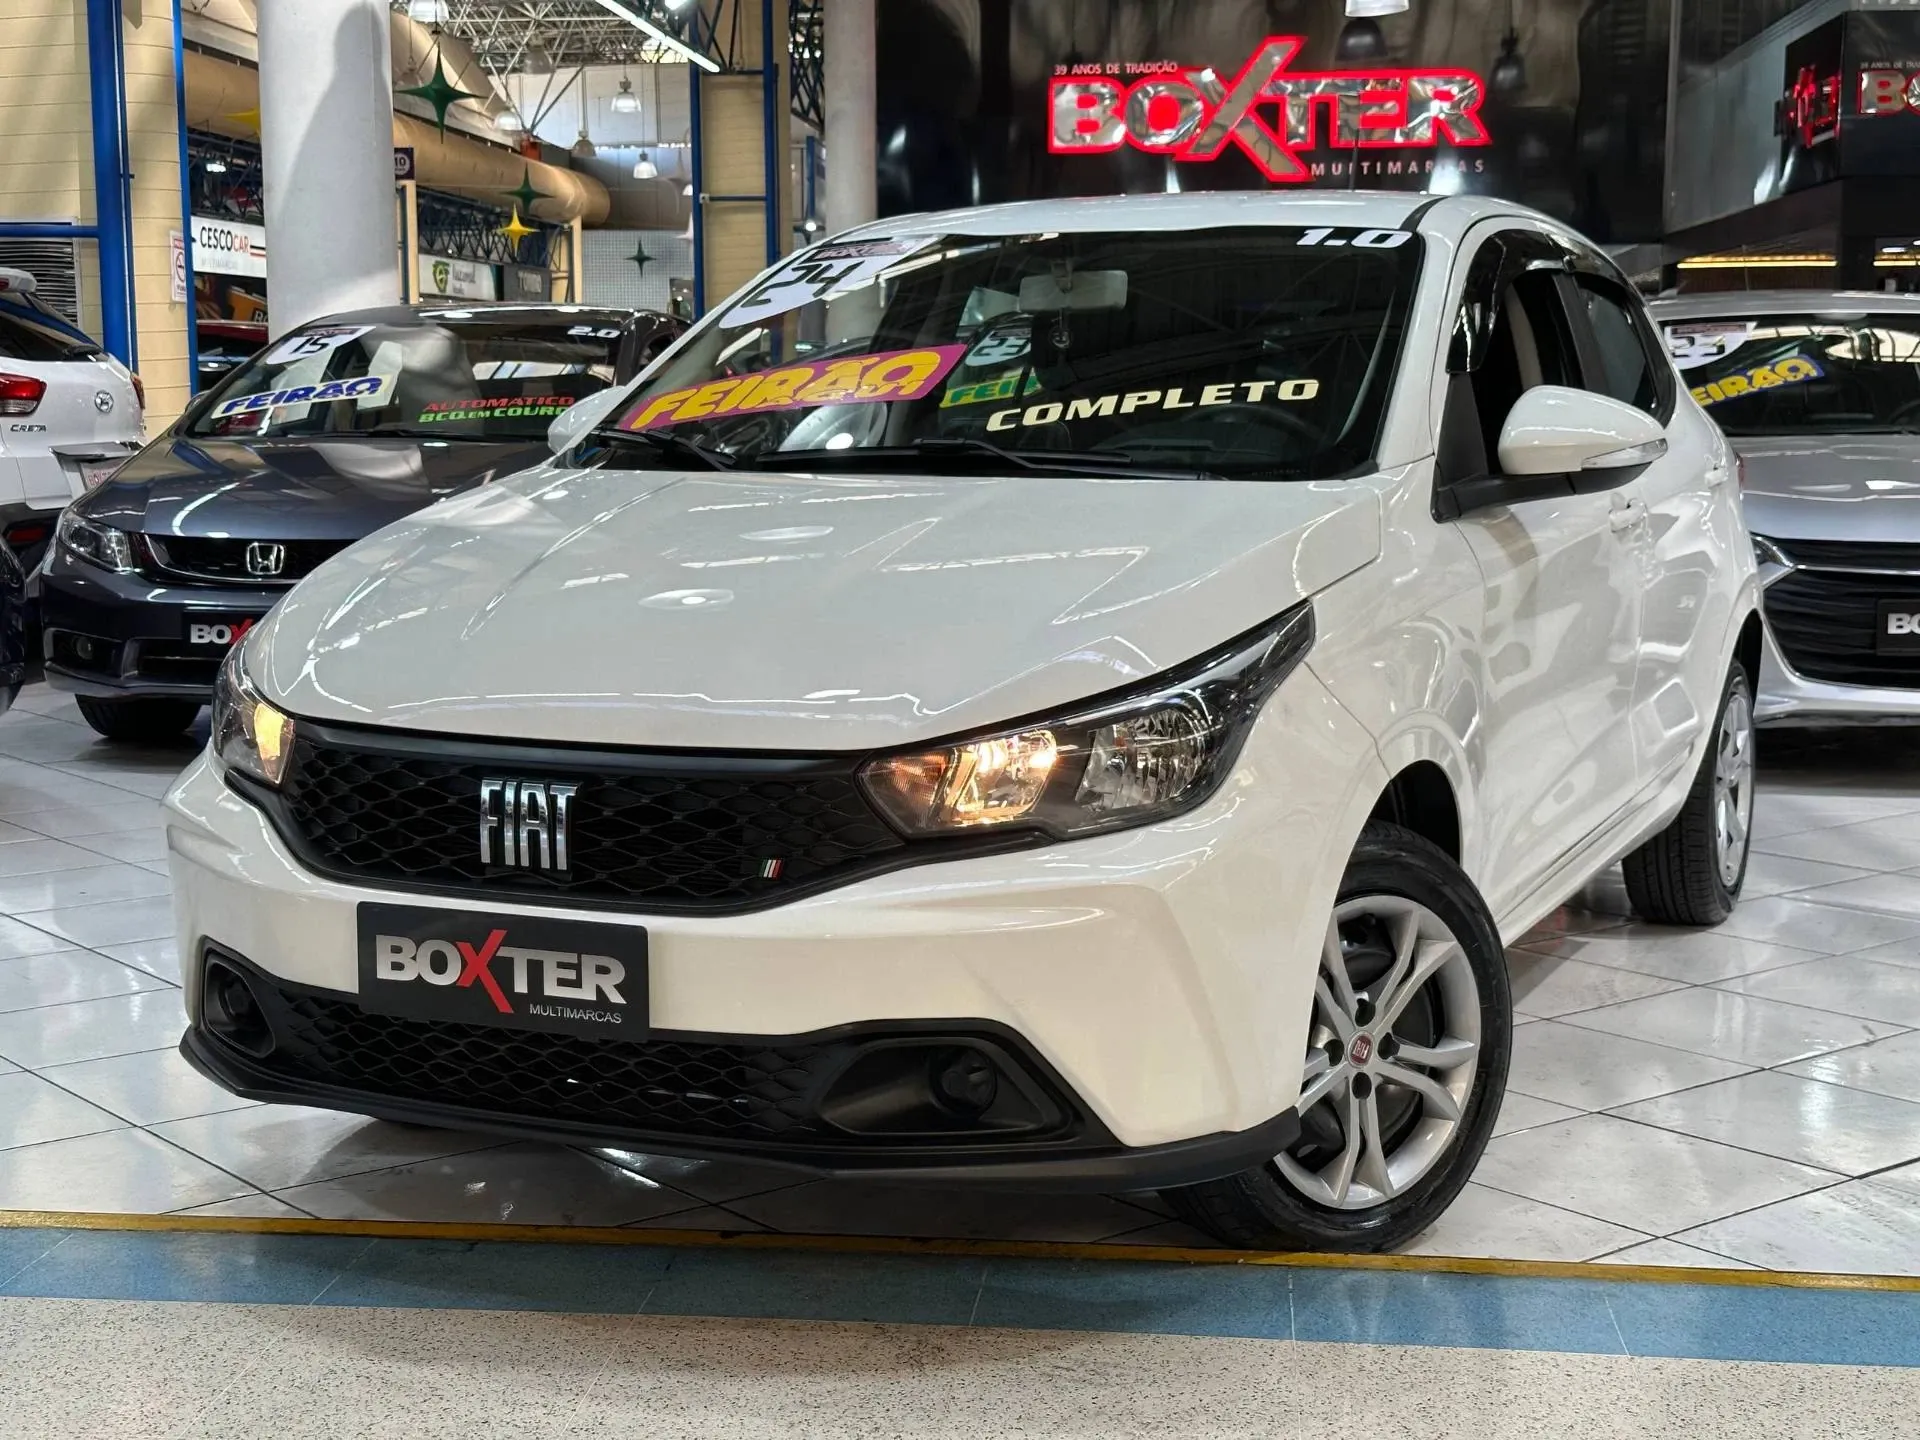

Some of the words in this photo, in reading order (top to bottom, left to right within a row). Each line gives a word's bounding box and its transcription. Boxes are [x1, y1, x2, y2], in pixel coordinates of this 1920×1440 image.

[1054, 64, 1068, 76] 39
[1071, 63, 1102, 75] ANOS
[1106, 63, 1121, 74] DE
[1125, 60, 1178, 74] TRADIÇÃO
[1048, 36, 1492, 182] BOXTER
[1311, 159, 1485, 176] MULTIMARAS
[200, 226, 249, 253] CESCOCAR
[1296, 227, 1413, 248] 1.0
[740, 260, 866, 308] 24
[567, 326, 621, 338] 2.0
[289, 336, 330, 354] 15
[985, 378, 1320, 432] COMPLETO
[10, 423, 47, 433] CRETA
[479, 778, 578, 872] FIAT
[375, 928, 628, 1014] BOXTER
[529, 1003, 622, 1024] MULTIMARCAS
